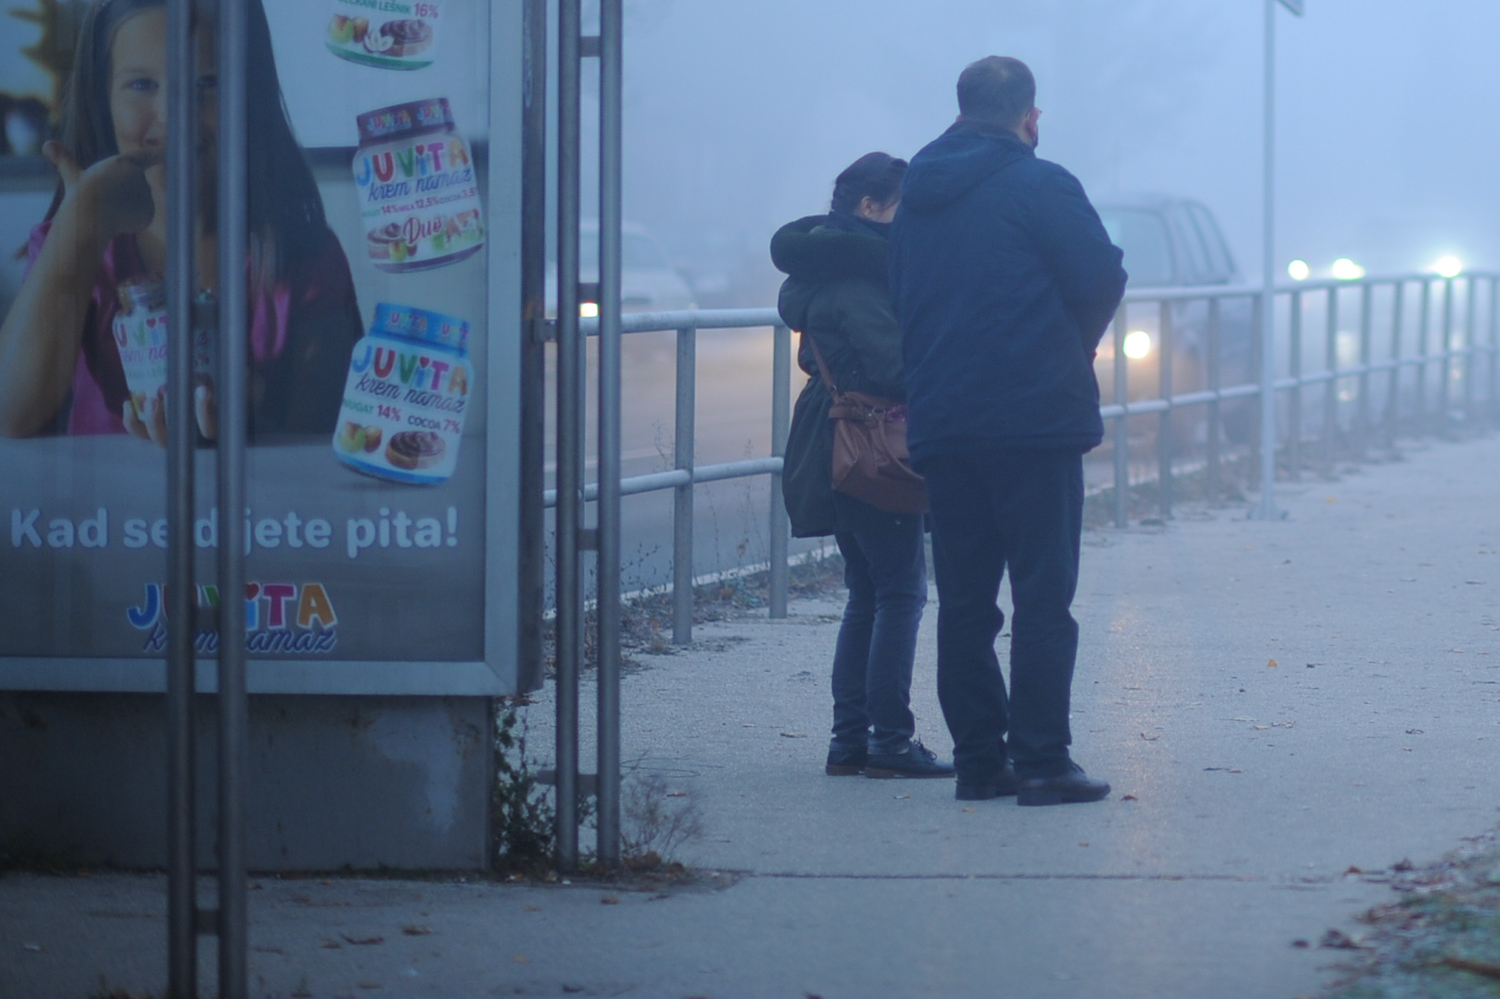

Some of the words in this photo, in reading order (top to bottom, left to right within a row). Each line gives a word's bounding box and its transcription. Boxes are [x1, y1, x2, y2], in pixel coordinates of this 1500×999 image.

[414, 2, 439, 19] 16%
[368, 181, 411, 202] krem
[415, 168, 472, 193] namaz
[355, 372, 401, 400] krem
[403, 387, 466, 414] namaz
[377, 404, 402, 422] 14%
[443, 418, 460, 434] 7%
[11, 507, 108, 548] Kad
[193, 506, 332, 557] djete
[346, 505, 458, 559] pita!
